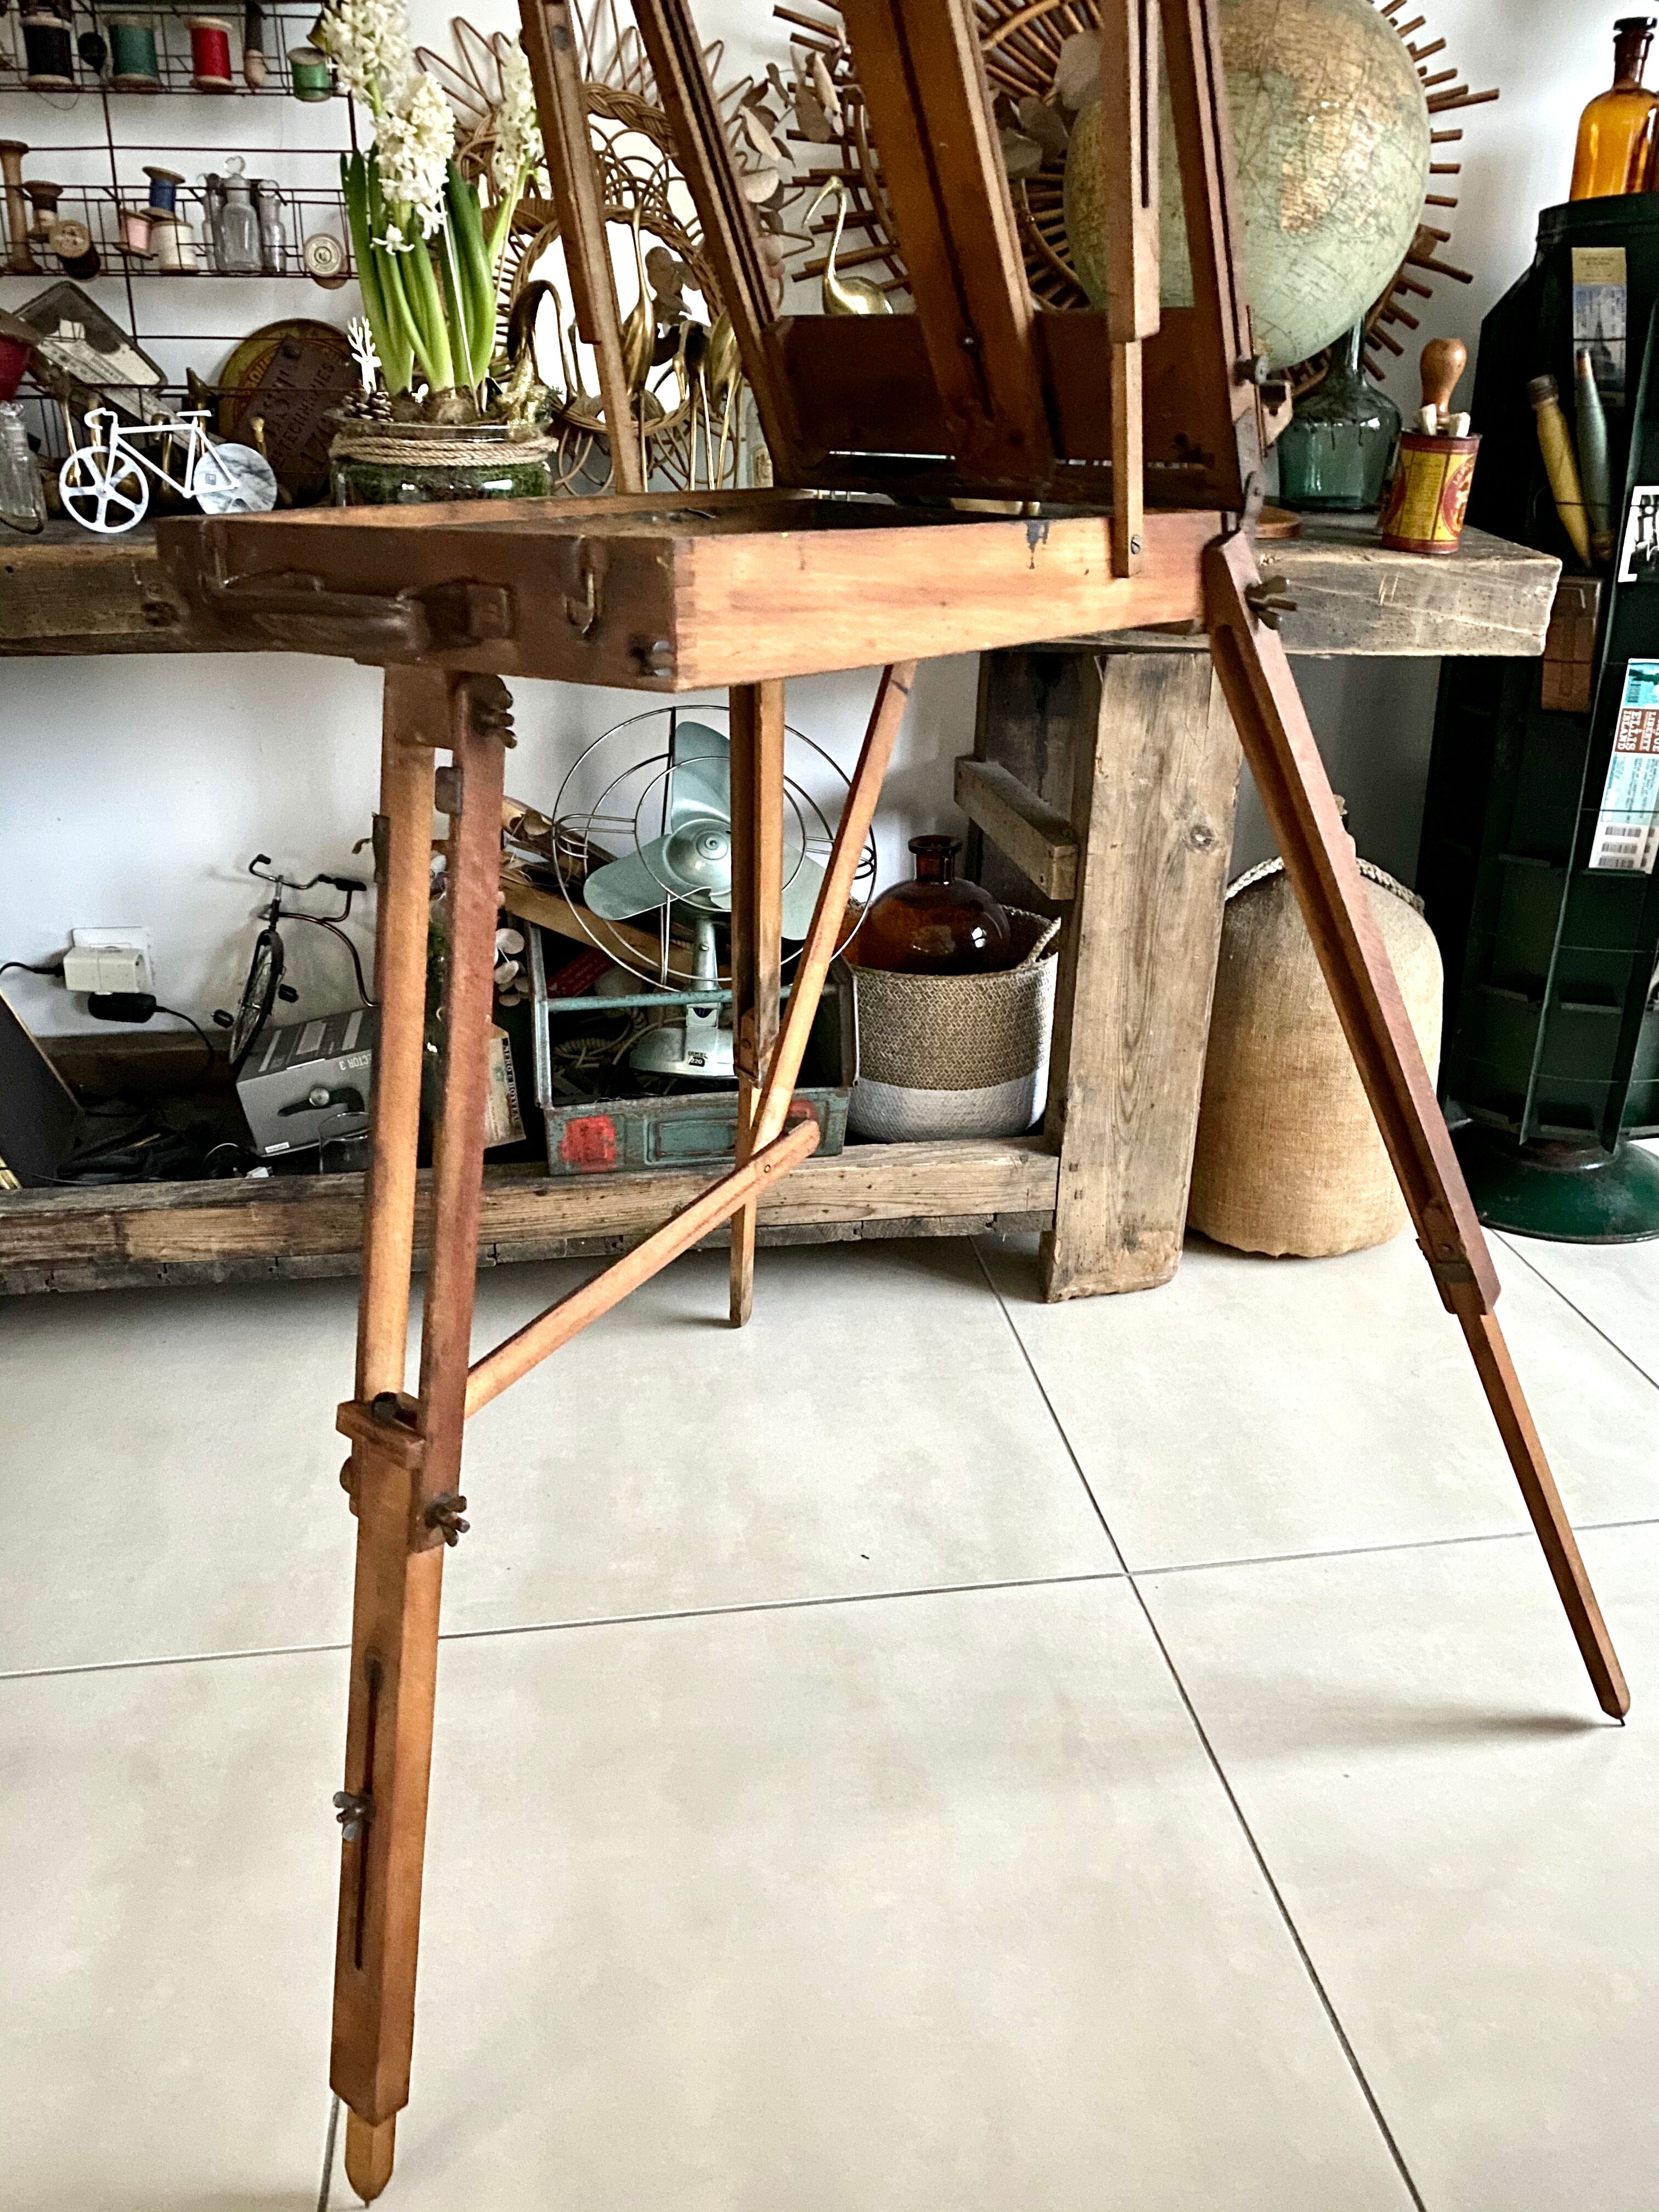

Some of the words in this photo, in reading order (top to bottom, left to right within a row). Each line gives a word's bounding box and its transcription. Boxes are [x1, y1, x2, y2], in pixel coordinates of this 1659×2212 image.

[1617, 710, 1632, 750] ISLAND
[1626, 710, 1641, 751] ELLIS
[1643, 711, 1656, 752] LIBERTY
[339, 1060, 346, 1070] 3
